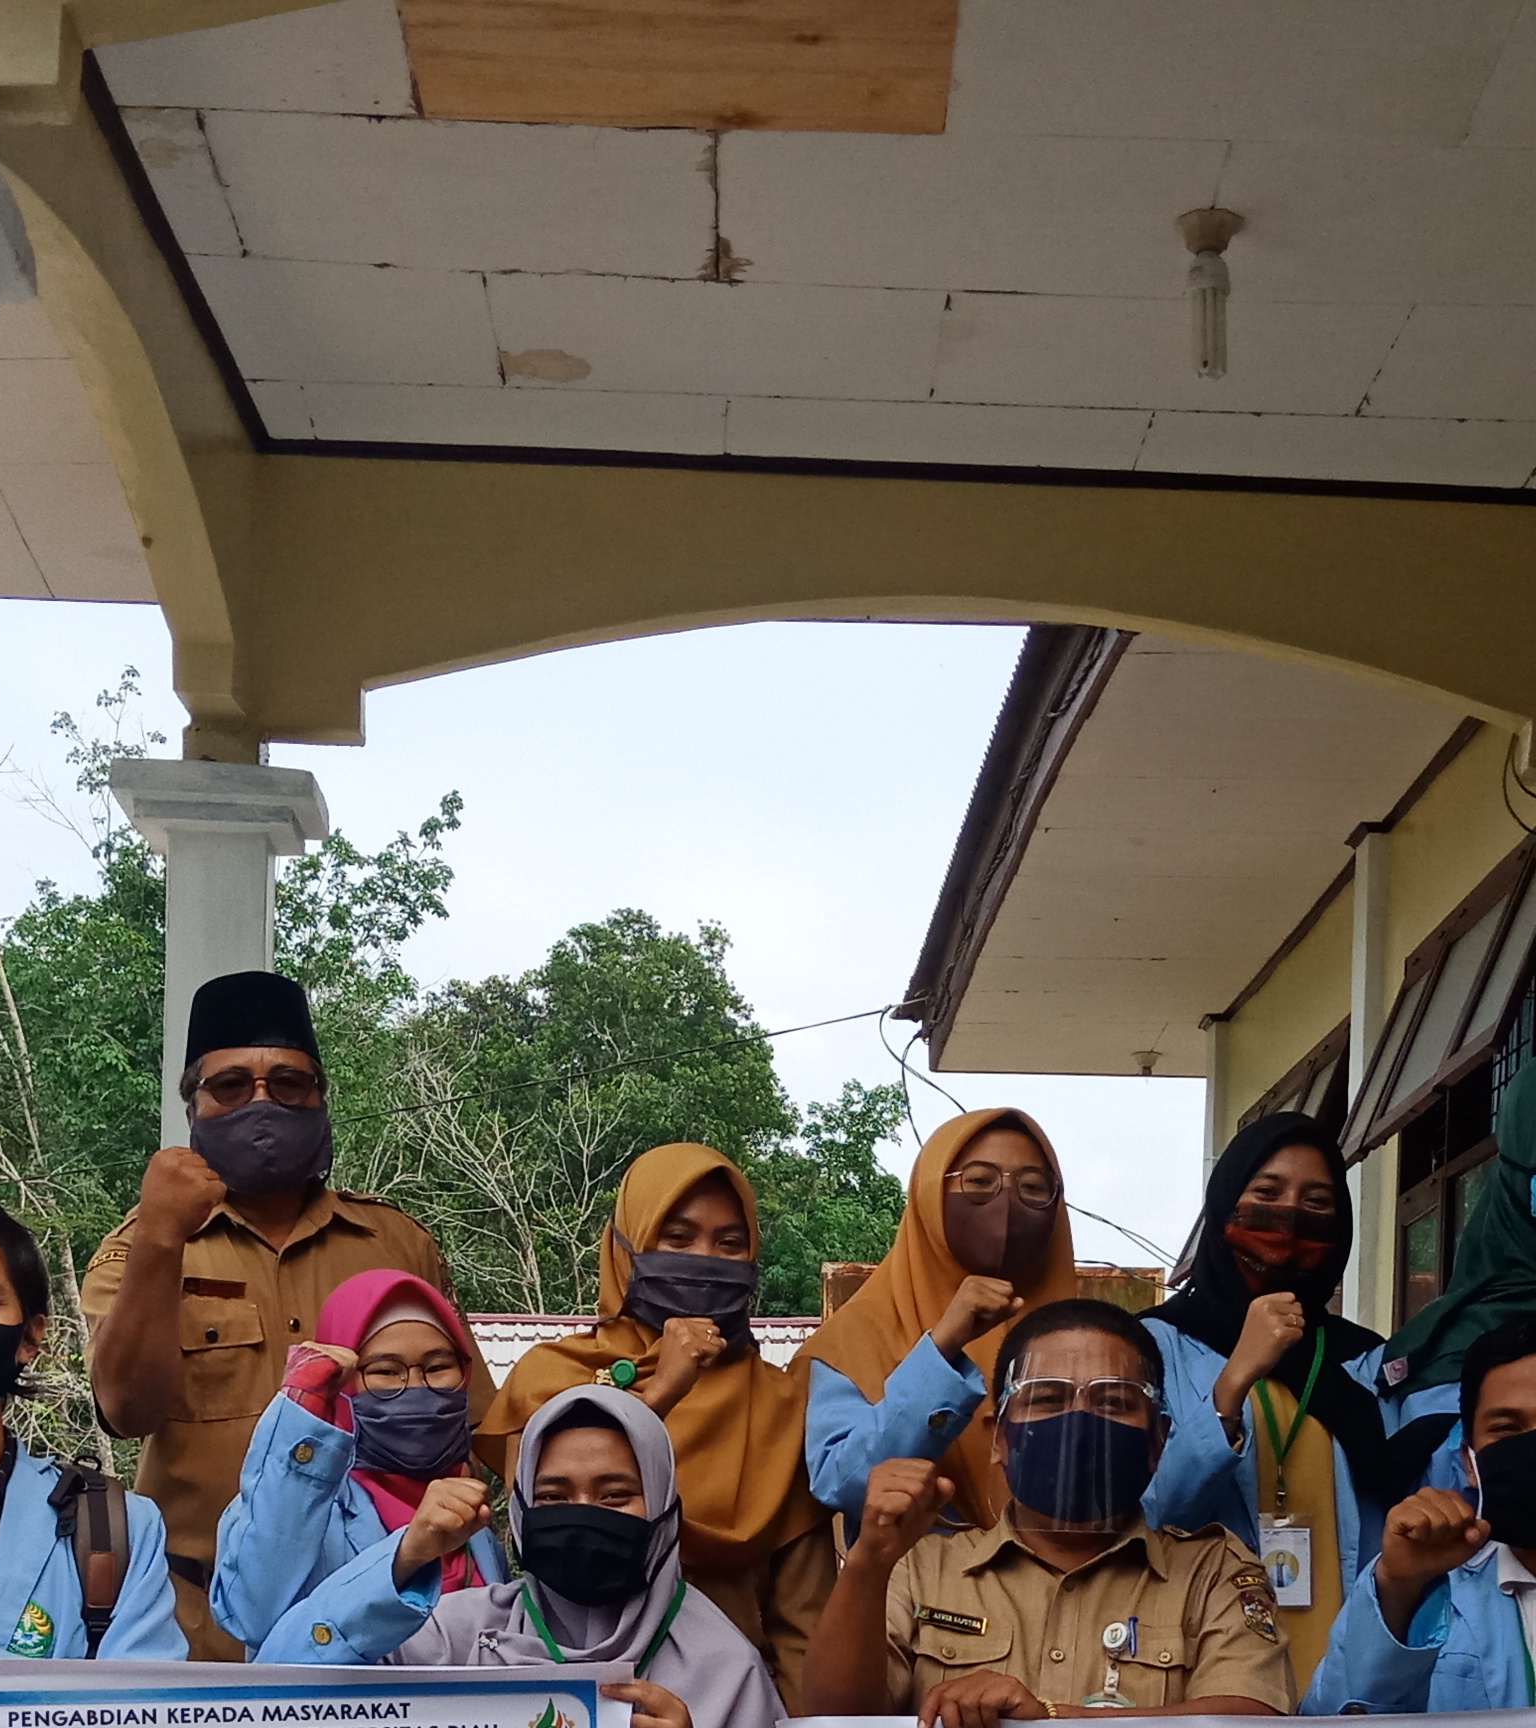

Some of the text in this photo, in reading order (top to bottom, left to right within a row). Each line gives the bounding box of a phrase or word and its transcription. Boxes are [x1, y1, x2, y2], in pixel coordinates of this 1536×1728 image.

[8, 1702, 411, 1728] PENGABDIAN KEPADA MASYARAKAT
